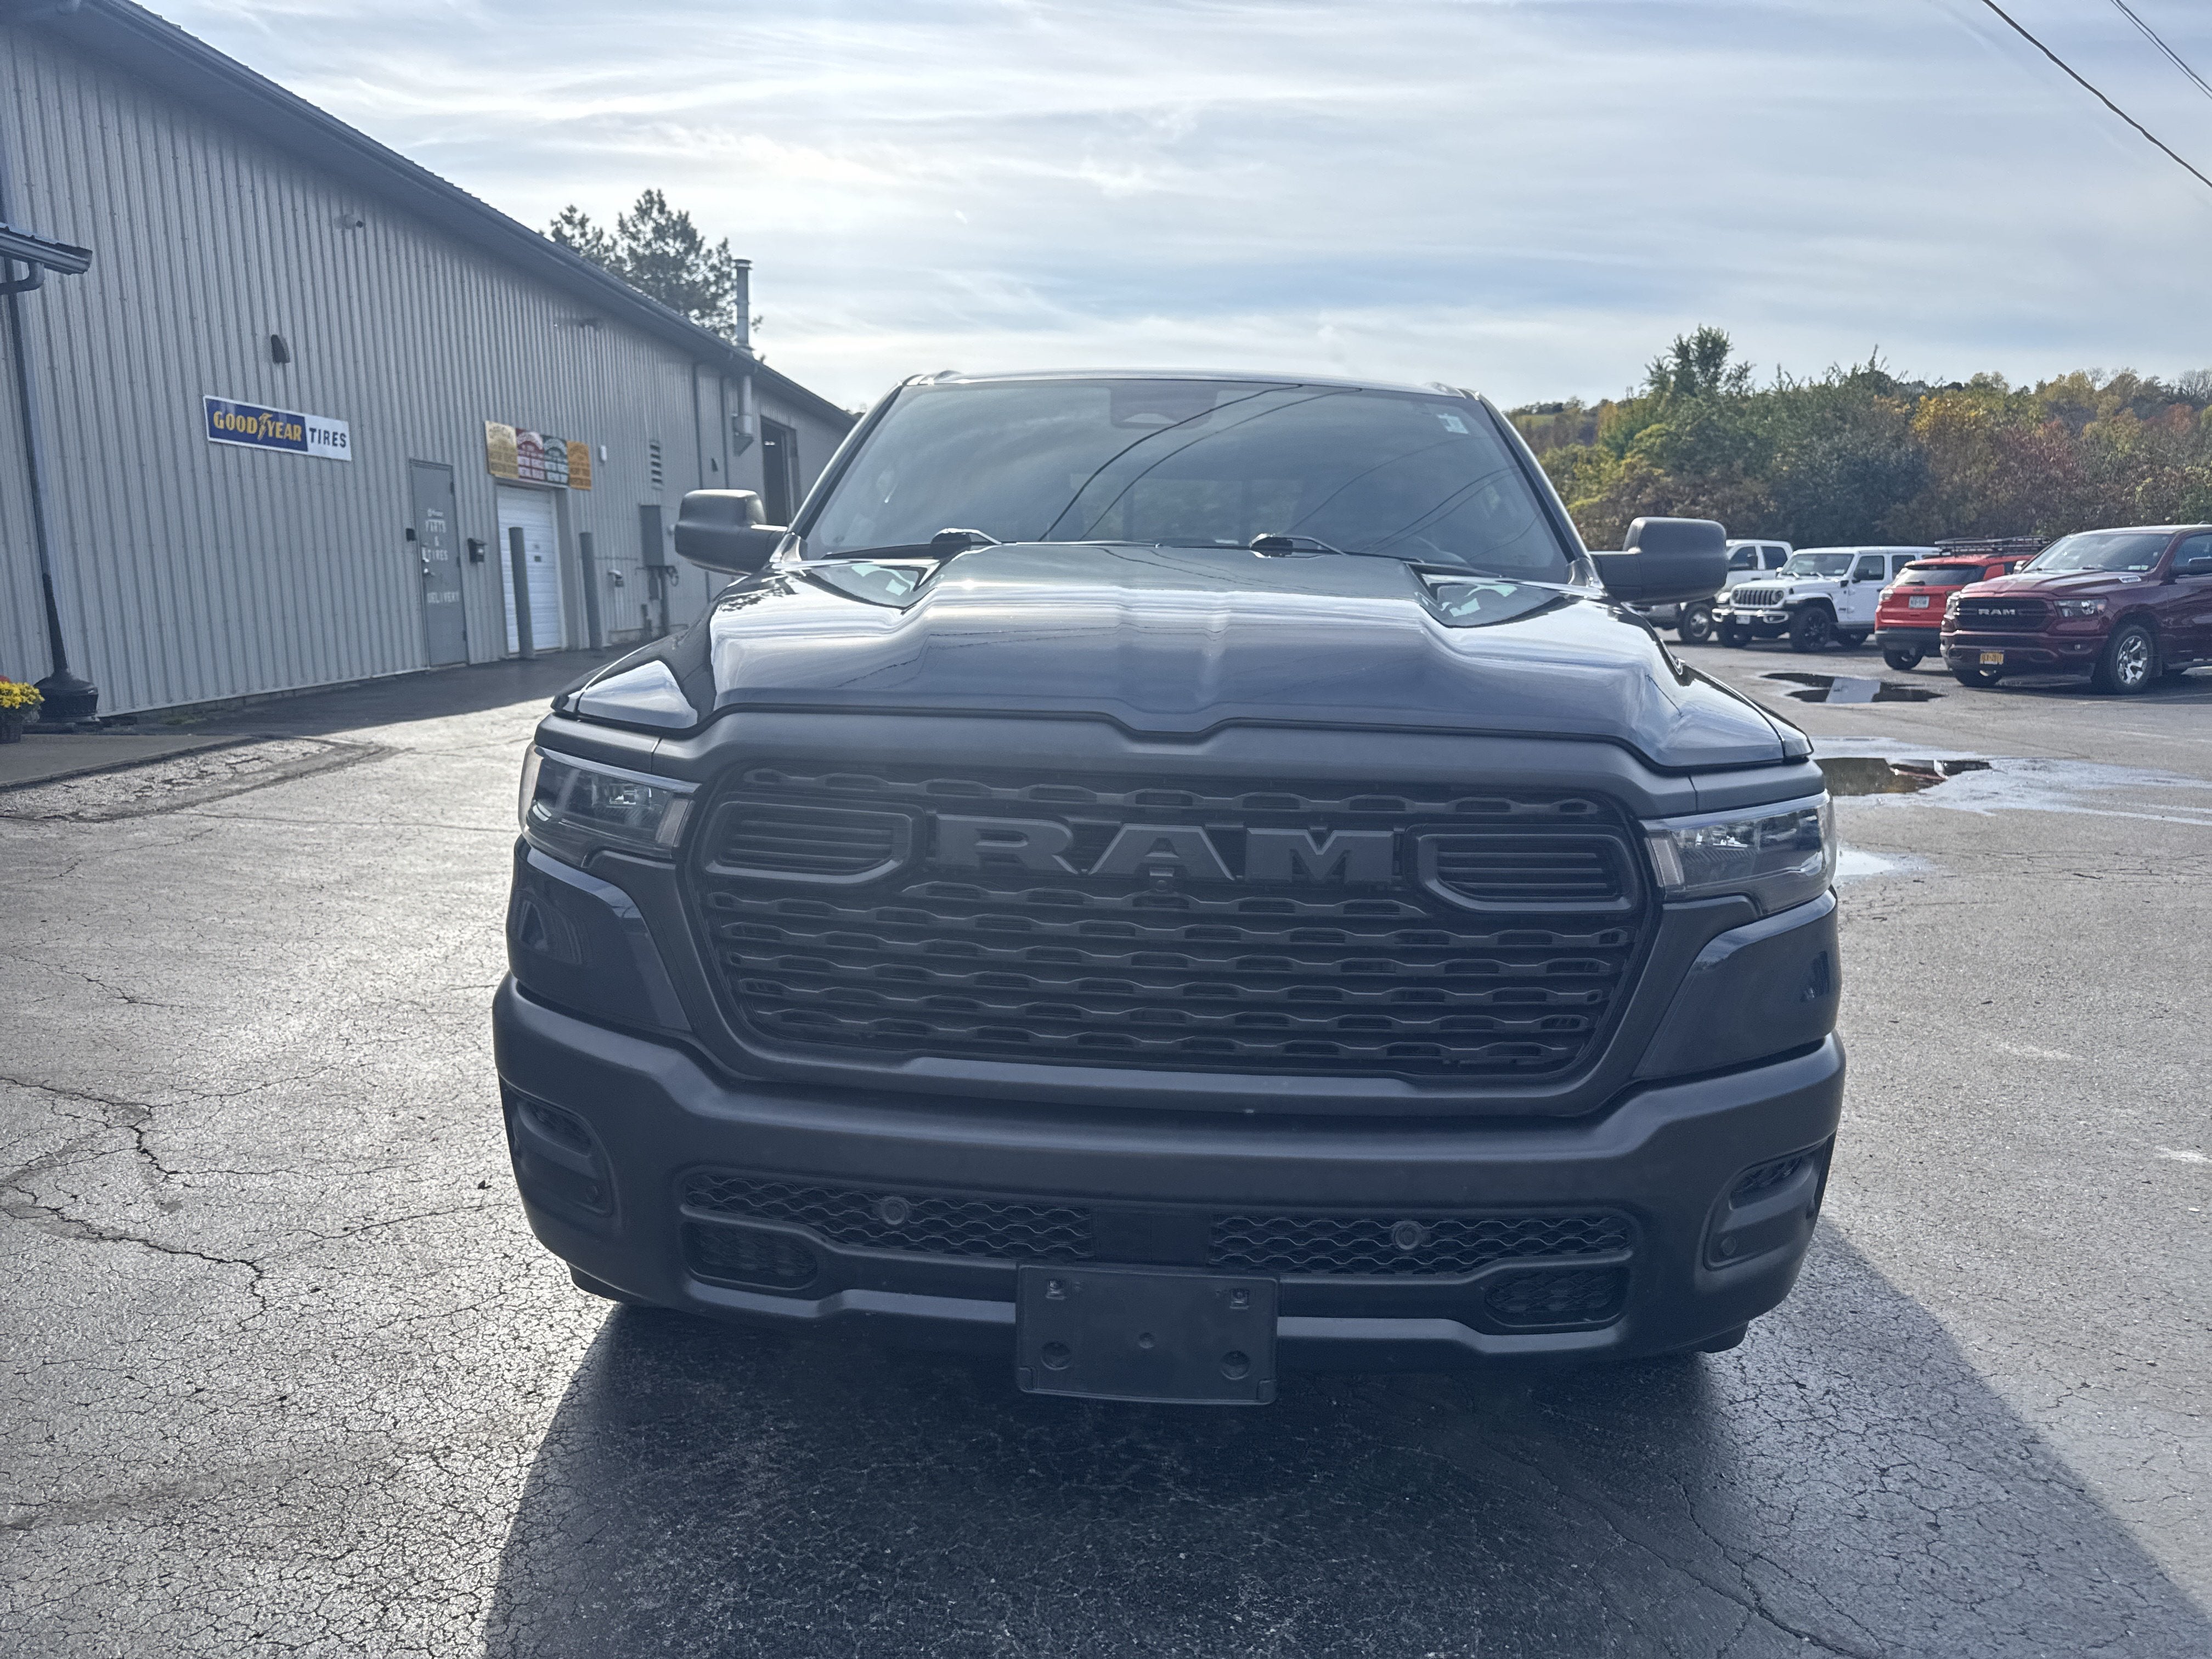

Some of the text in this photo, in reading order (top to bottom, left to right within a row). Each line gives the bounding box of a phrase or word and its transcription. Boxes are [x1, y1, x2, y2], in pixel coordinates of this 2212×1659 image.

[213, 411, 347, 448] GOODYEAR TIRES
[935, 813, 1395, 884] RAM
